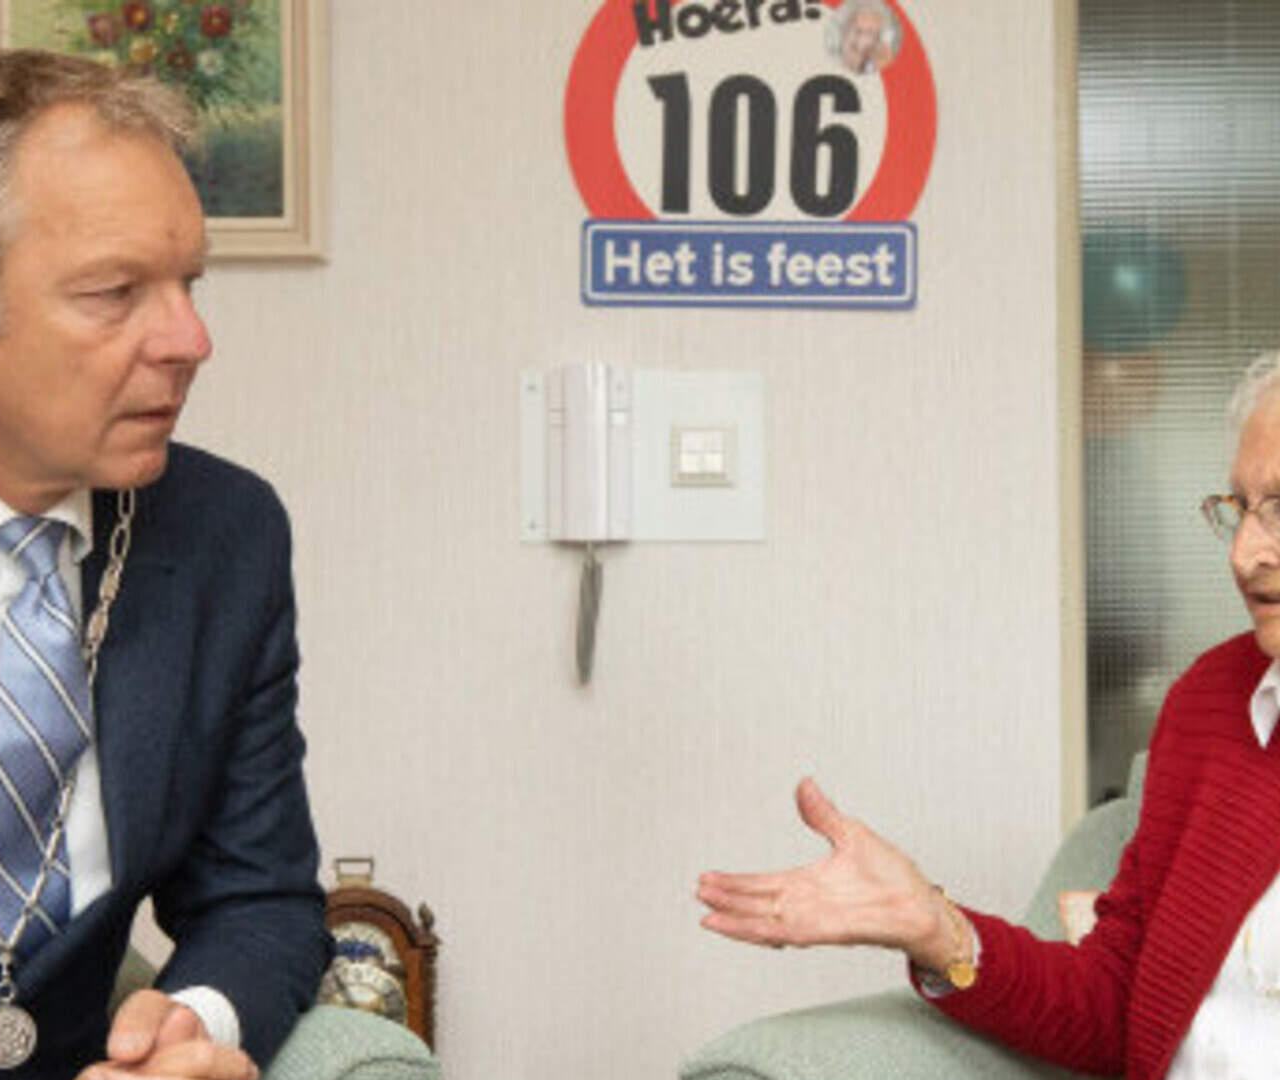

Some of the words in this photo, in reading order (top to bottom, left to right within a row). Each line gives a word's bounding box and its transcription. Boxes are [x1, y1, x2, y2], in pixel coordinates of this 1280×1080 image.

[647, 72, 861, 217] 106
[604, 240, 696, 286] Het
[712, 242, 754, 286] is
[767, 242, 896, 287] feest
